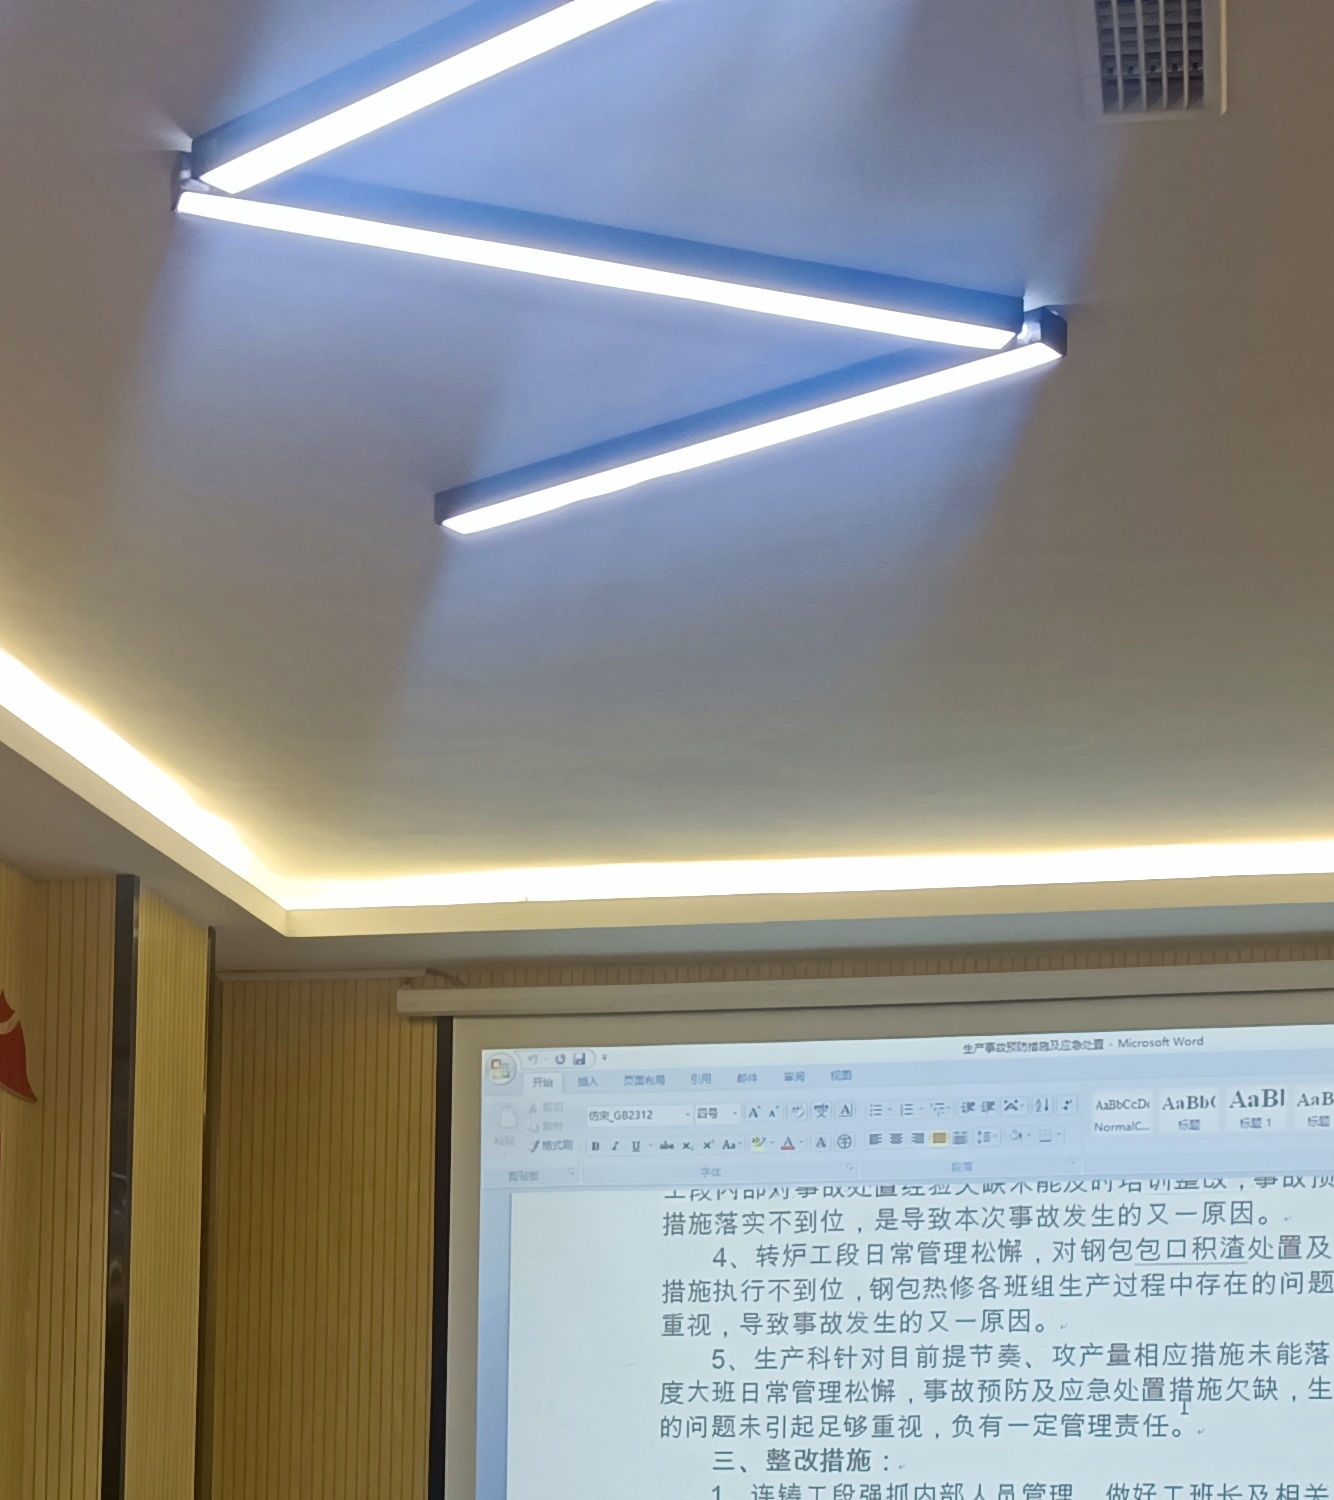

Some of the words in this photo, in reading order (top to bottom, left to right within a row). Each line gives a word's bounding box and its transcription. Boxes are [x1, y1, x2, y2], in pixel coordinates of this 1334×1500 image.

[1118, 1037, 1170, 1048] Microsoft
[1173, 1036, 1204, 1047] Word
[532, 1077, 553, 1088] 开始
[578, 1076, 598, 1087] 插入
[624, 1074, 665, 1086] 页面布局
[691, 1073, 712, 1085] 引用
[831, 1070, 852, 1081] 视图
[697, 1107, 718, 1119] 四号
[662, 1200, 1269, 1236] 措施落实不到位，是导致本次事故发生的又一原因。
[662, 1308, 1046, 1338] 重视，导致事故发生的又一原因。
[660, 1412, 1186, 1439] 的问题未引起足够重视，负有一定管理责任。
[712, 1448, 890, 1474] 三、整改措施：
